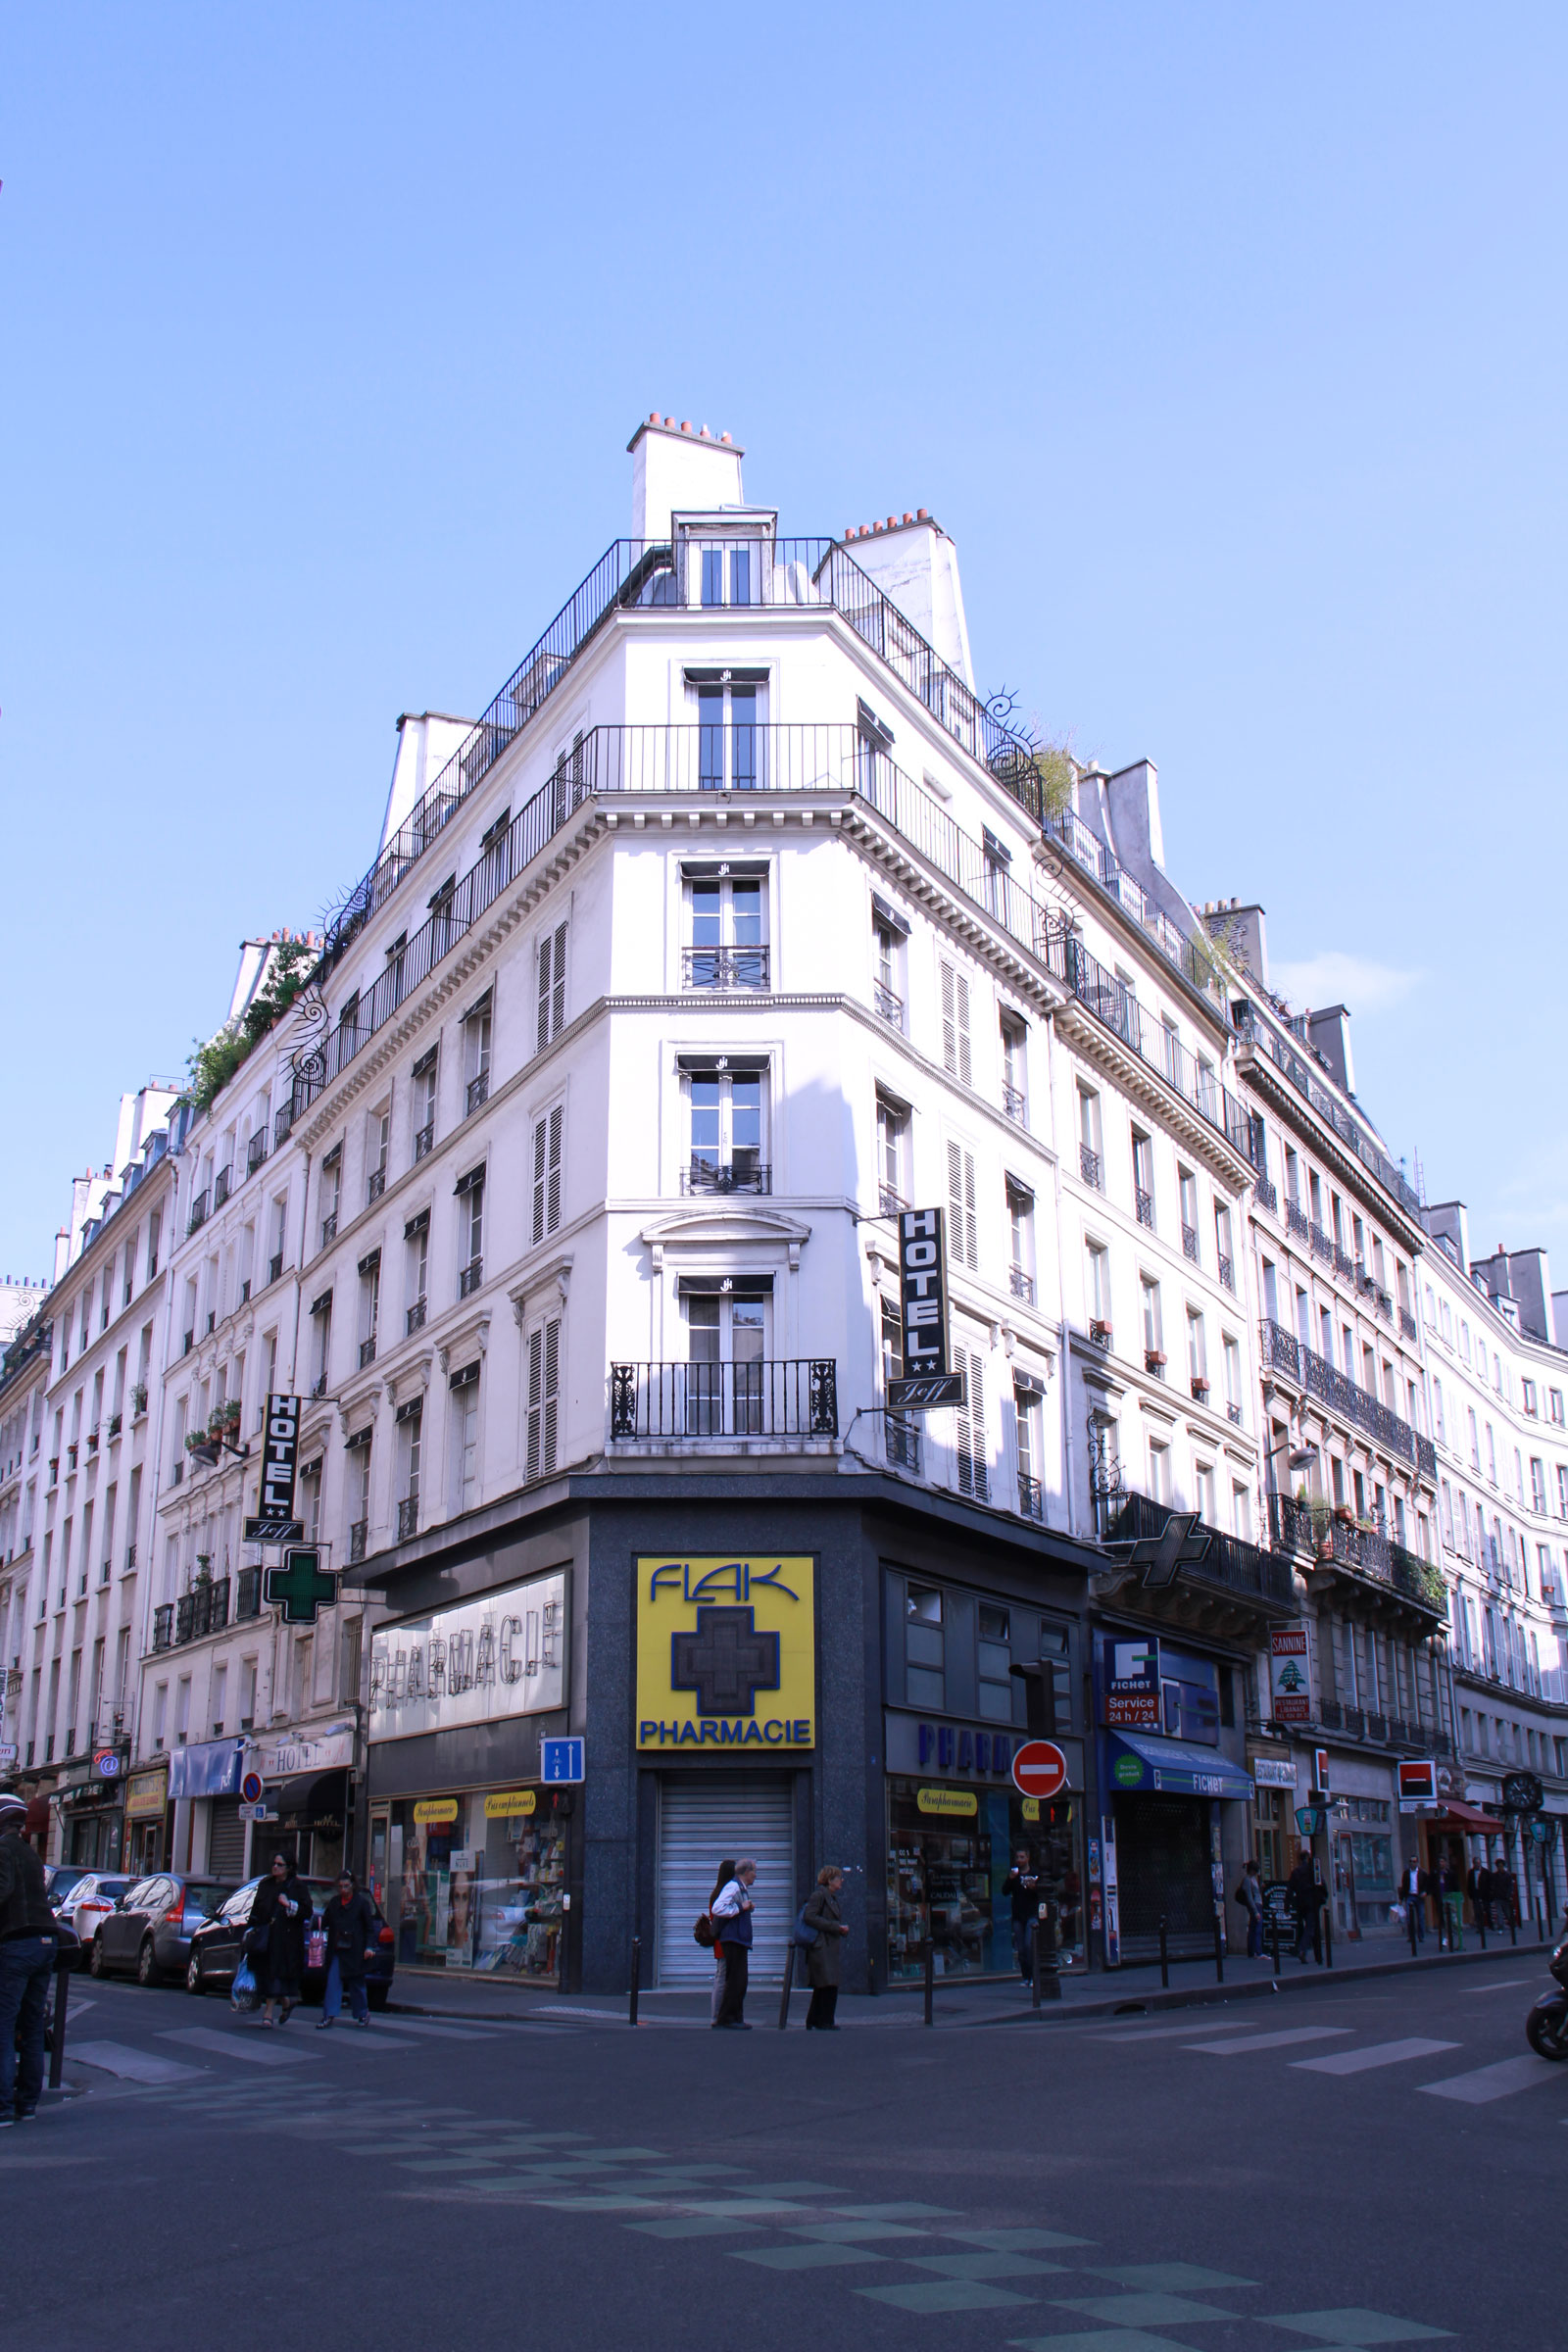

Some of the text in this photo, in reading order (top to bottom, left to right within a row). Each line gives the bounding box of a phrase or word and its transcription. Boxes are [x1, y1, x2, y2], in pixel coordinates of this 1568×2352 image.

[904, 1209, 941, 1358] HOTEL
[897, 1378, 954, 1404] Jeff
[264, 1395, 298, 1506] HOTEL
[252, 1522, 298, 1540] Jeff
[651, 1563, 800, 1602] FLAK
[1272, 1635, 1306, 1653] SANNINE
[368, 1600, 563, 1714] PHARMACIE
[1108, 1696, 1154, 1709] Service
[1108, 1712, 1121, 1722] 24
[1124, 1711, 1132, 1721] h
[1142, 1711, 1154, 1721] 24
[640, 1719, 811, 1744] PHARMACIE
[276, 1745, 320, 1773] HOTEL
[918, 1724, 1065, 1773] PHARM
[416, 1804, 455, 1820] Parapharmacie
[921, 1792, 973, 1811] Parapharmacie
